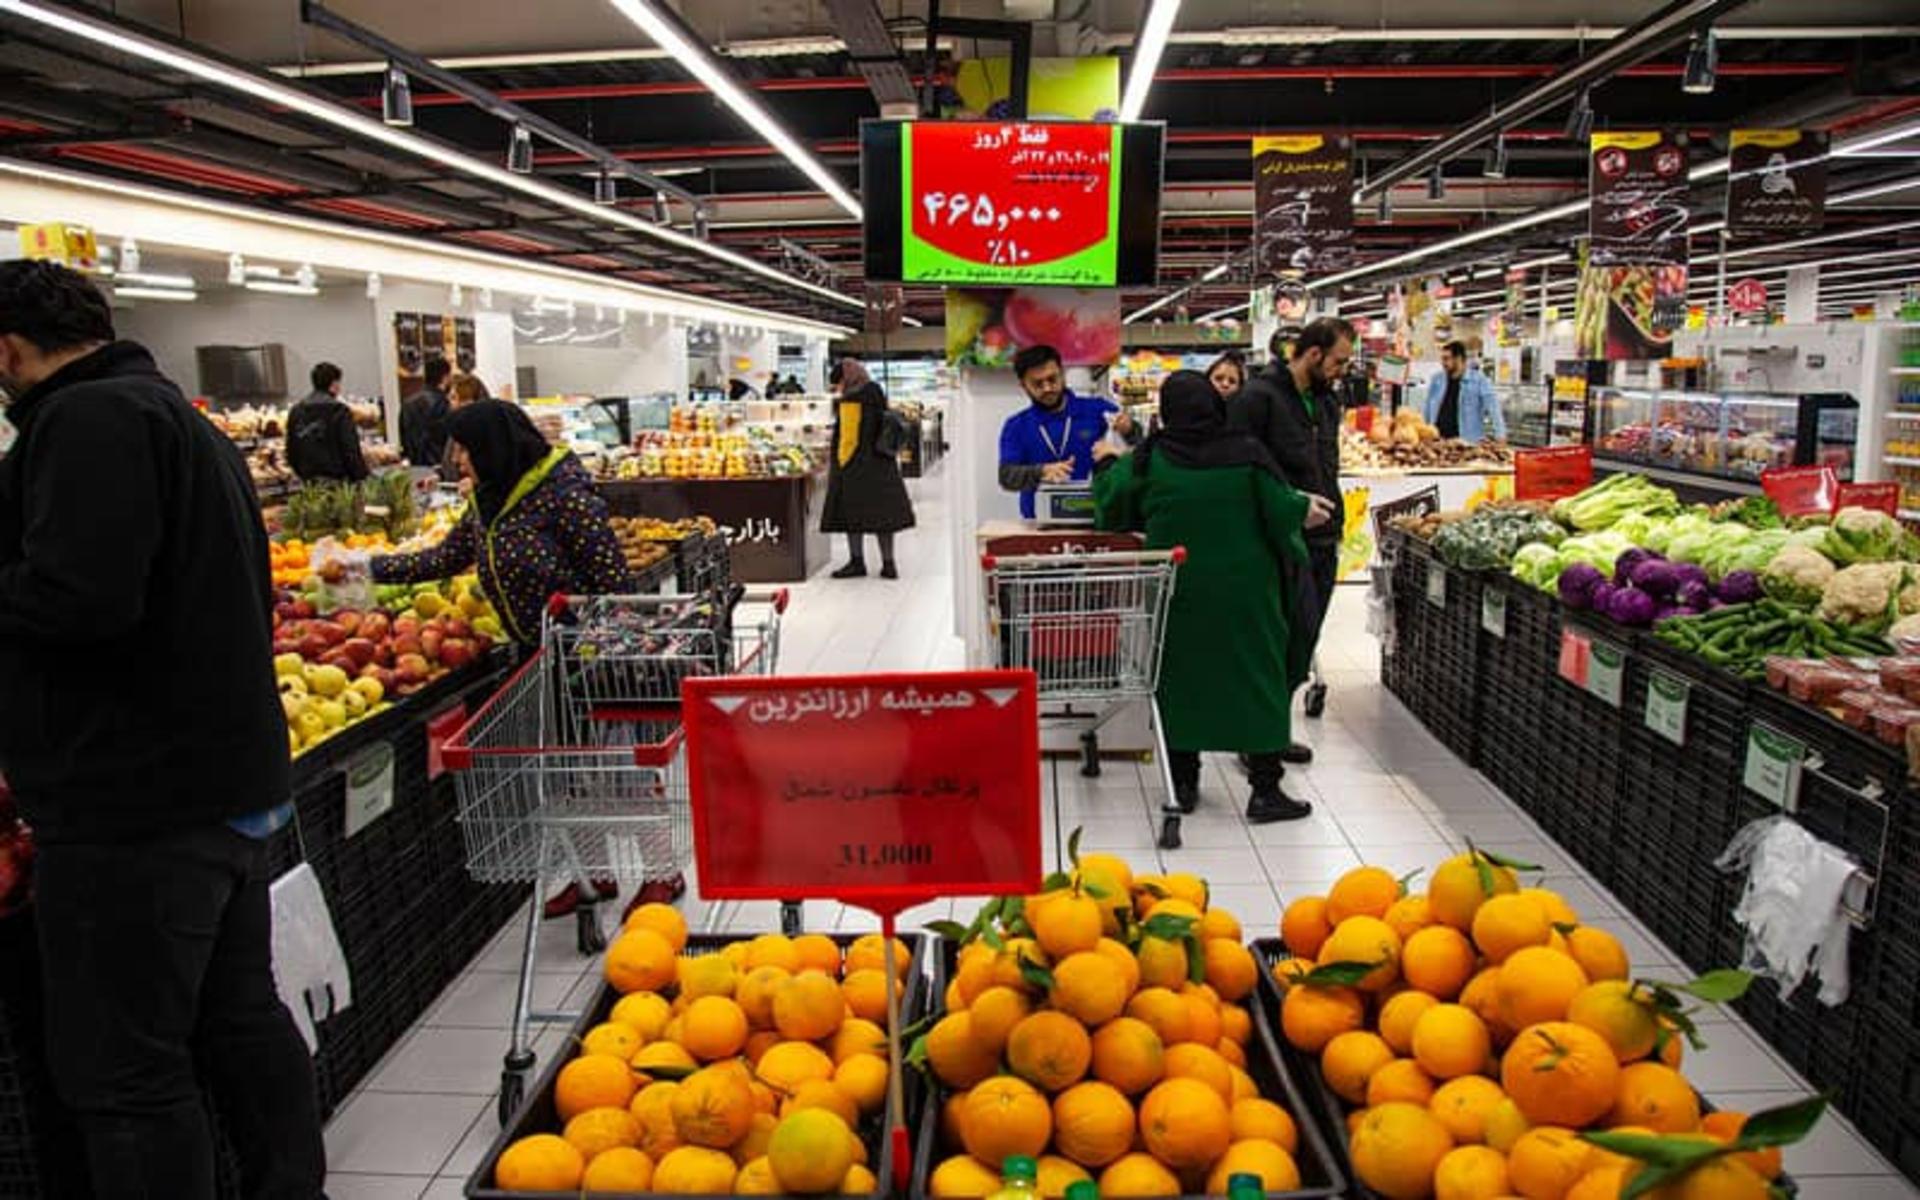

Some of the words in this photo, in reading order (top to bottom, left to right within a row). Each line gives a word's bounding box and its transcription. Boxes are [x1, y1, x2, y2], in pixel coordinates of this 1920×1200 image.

[1015, 123, 1049, 144] فقط
[719, 518, 780, 546] بازارچ
[748, 687, 871, 722] ارزانترین
[881, 686, 975, 715] همیشه
